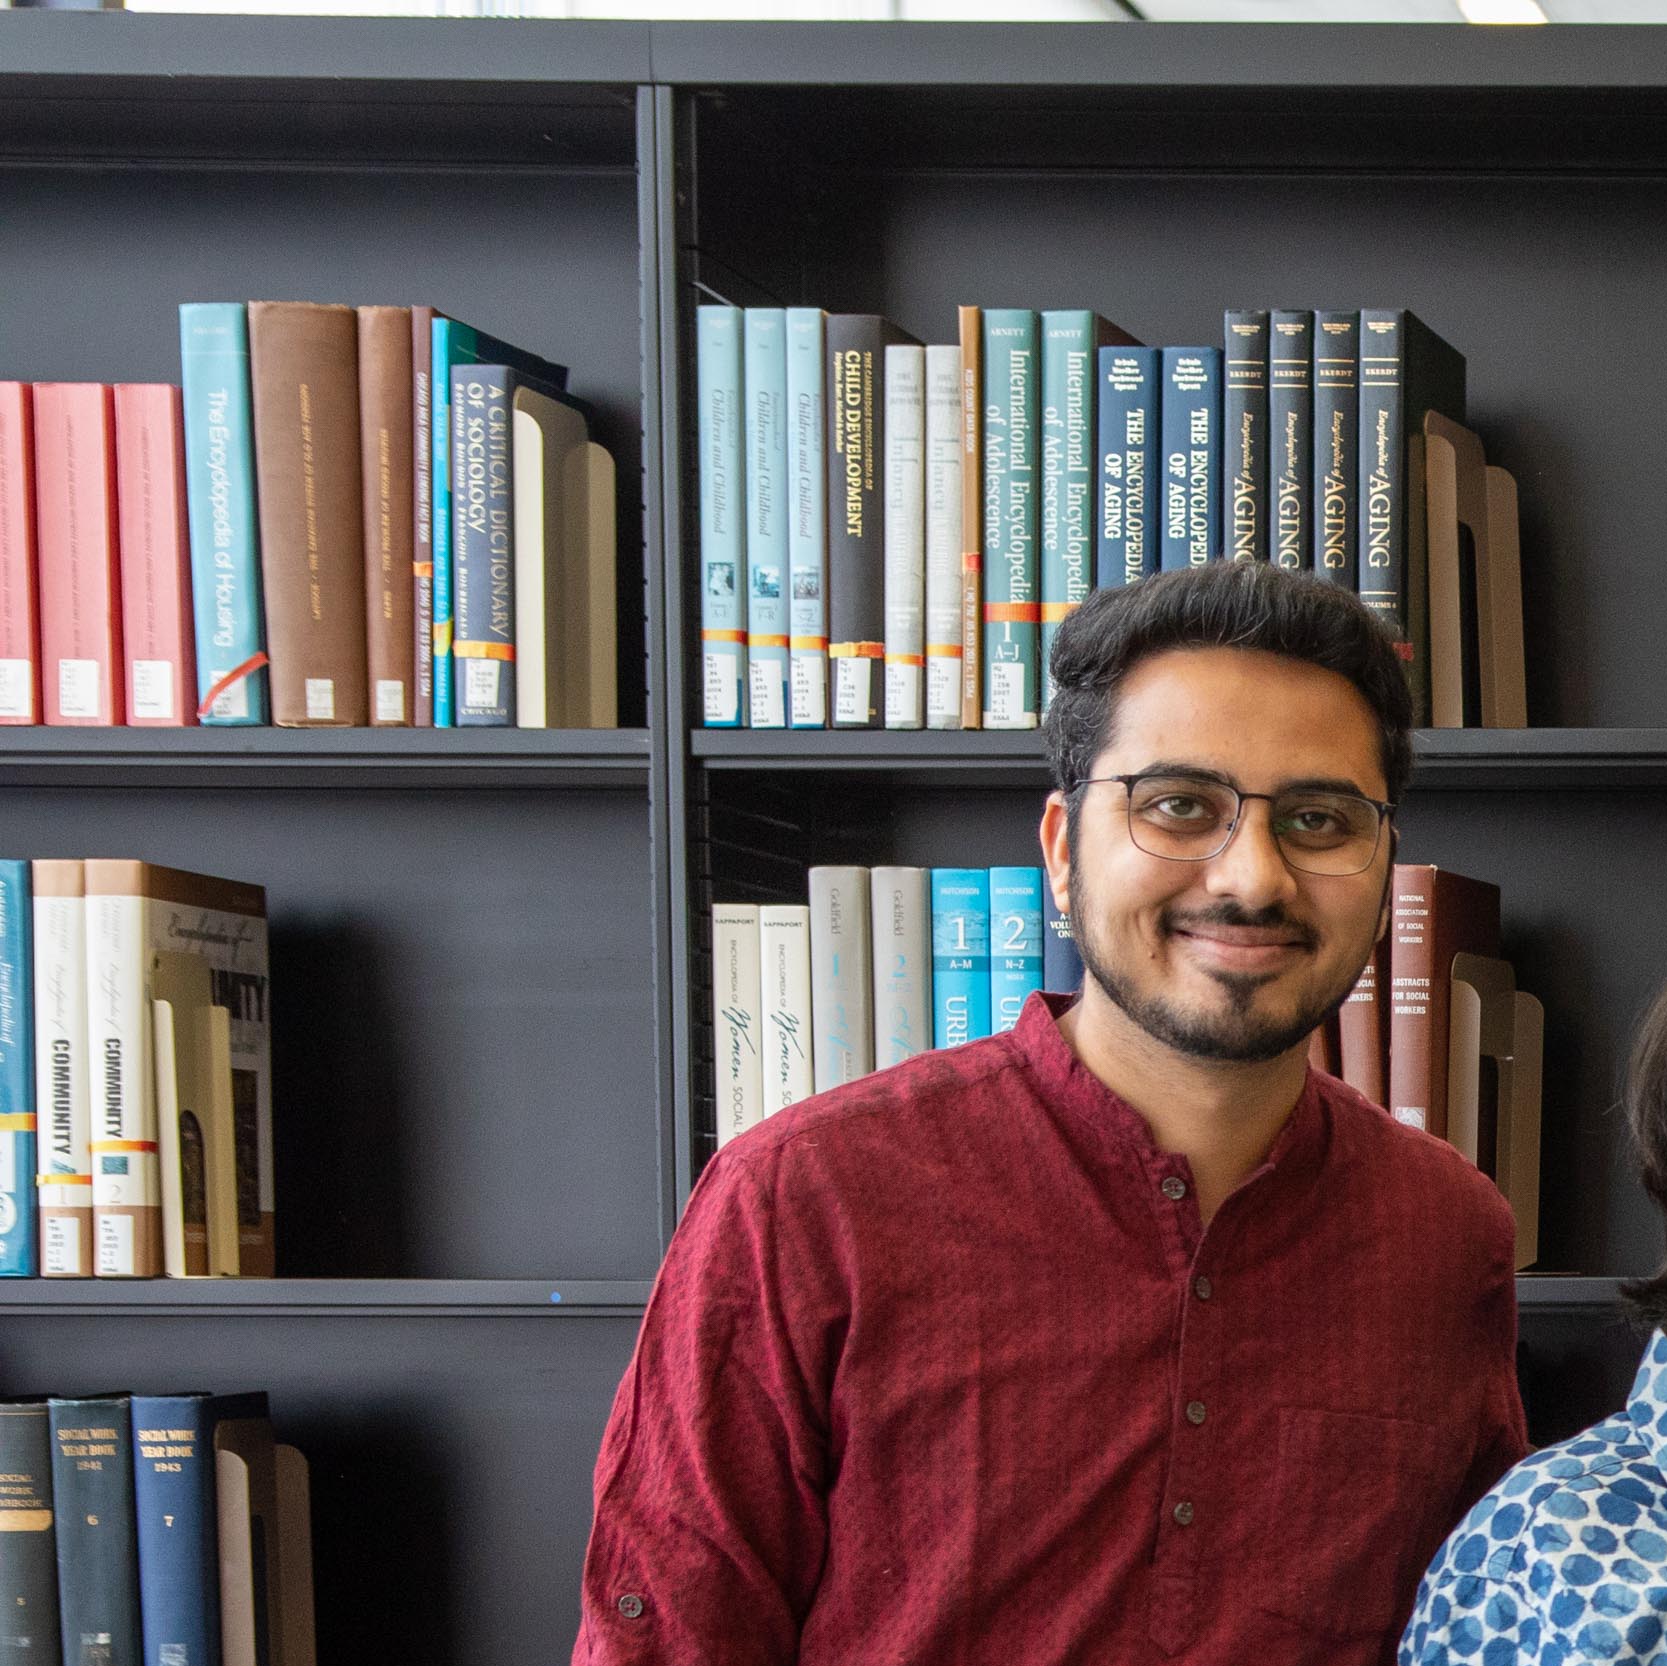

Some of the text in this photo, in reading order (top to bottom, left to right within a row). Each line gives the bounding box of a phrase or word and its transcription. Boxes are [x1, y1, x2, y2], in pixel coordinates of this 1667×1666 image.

[467, 382, 486, 534] OF SOCIOLOGY
[845, 351, 862, 537] CHILD DEVELOPMENT
[986, 432, 1006, 548] Adolescence
[1004, 350, 1032, 604] International Encyclopedia
[1104, 454, 1122, 539] OF AGING
[1125, 408, 1144, 584] THE ENCYCLOPEDIA
[207, 388, 236, 646] The Encyclopedia of Housing
[487, 384, 510, 638] A CRITICAL DICTIONARY
[1369, 474, 1392, 568] AGING
[951, 916, 970, 950] 1
[1002, 916, 1029, 950] 2
[1392, 978, 1430, 987] ABSTRACTS
[1394, 1006, 1426, 1014] WORKERS
[1406, 992, 1430, 1000] SOCIAL
[52, 1040, 71, 1154] COMMUNITY
[105, 1038, 122, 1138] COMMUNITY
[721, 1006, 756, 1128] Women SOCIAL
